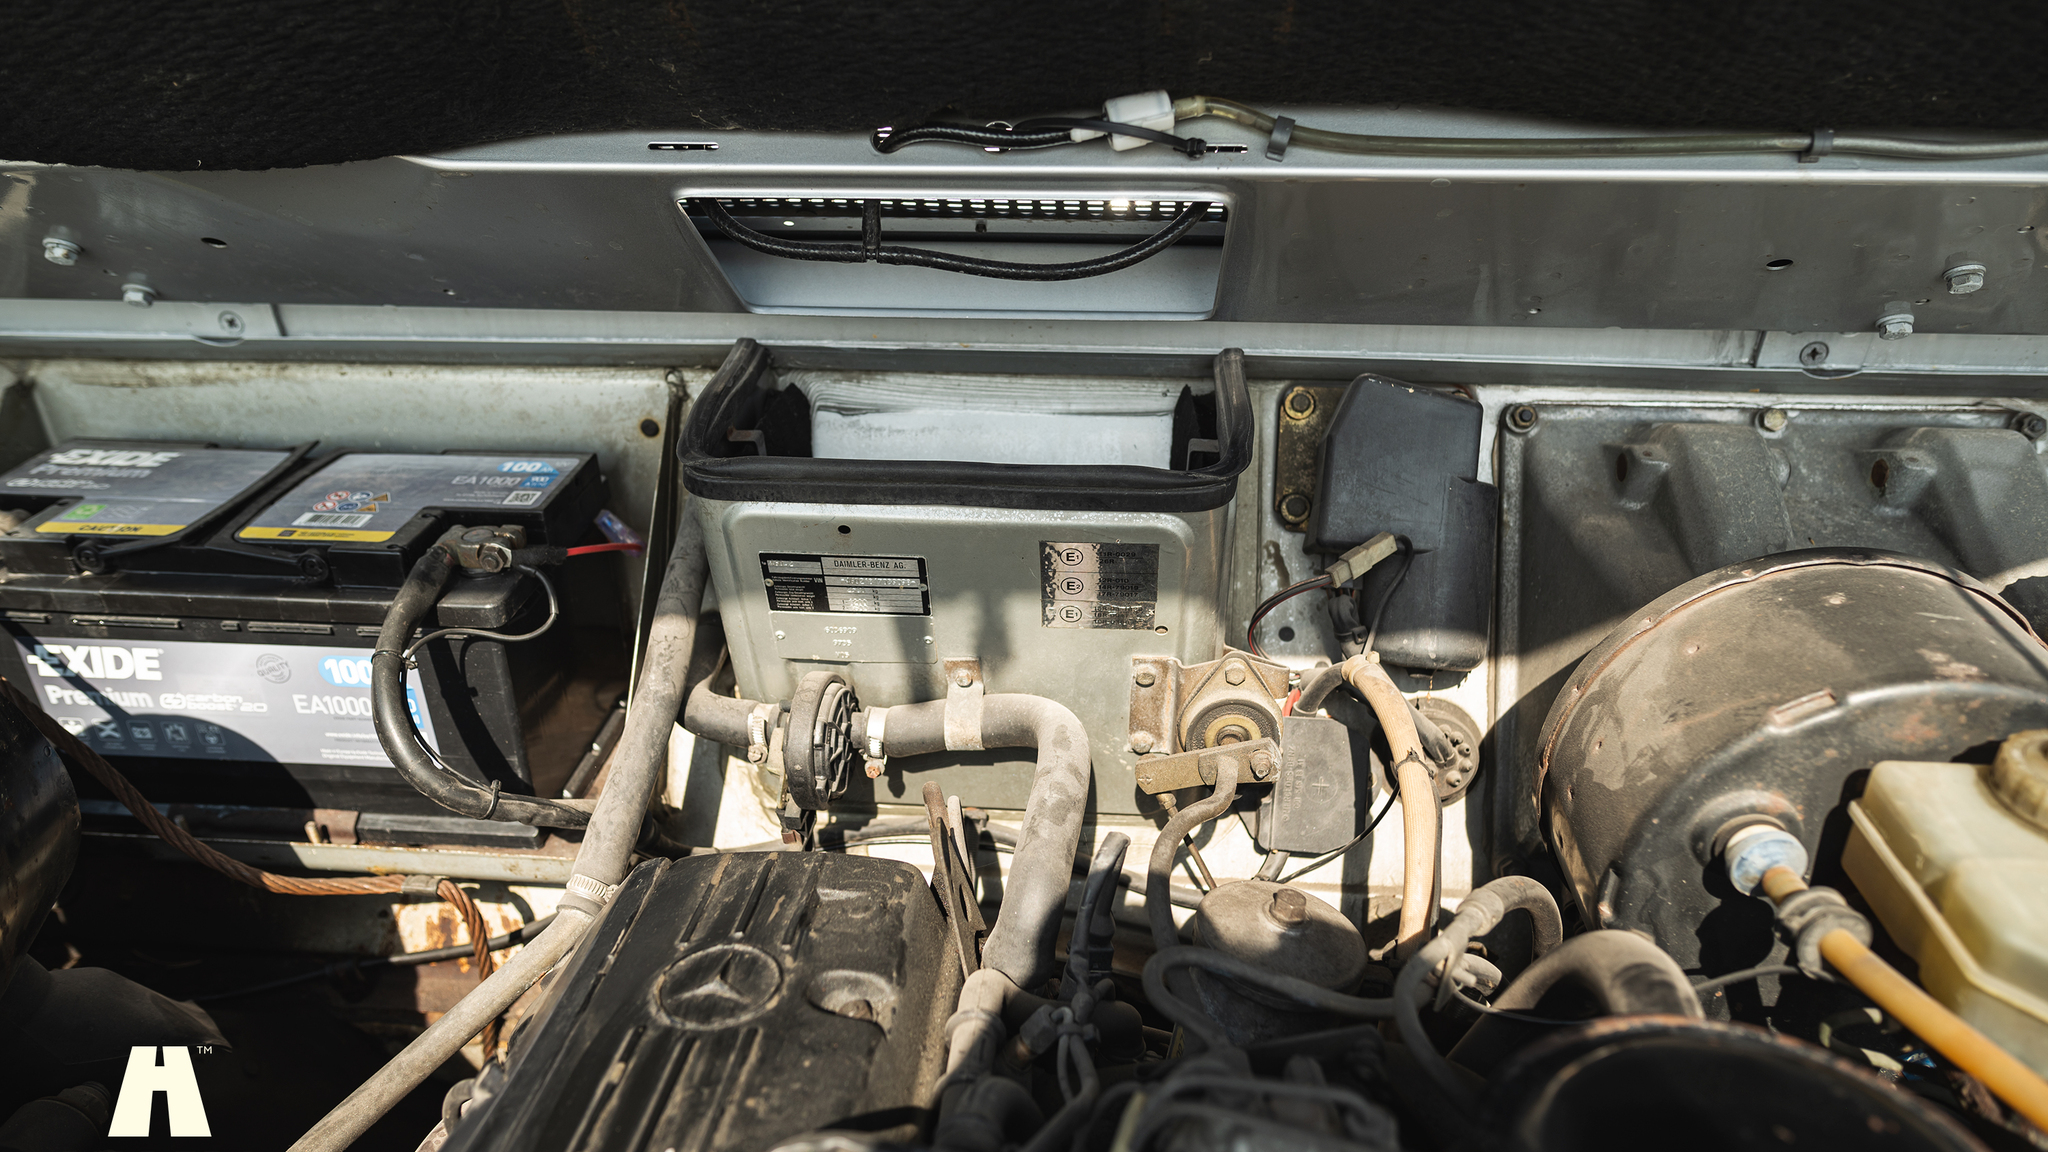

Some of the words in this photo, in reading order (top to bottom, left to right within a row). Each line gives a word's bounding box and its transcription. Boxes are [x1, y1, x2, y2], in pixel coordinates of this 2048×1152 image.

[502, 461, 541, 472] 100
[451, 475, 522, 486] EA1000
[833, 560, 891, 569] DAIMLER-BENZ
[27, 644, 163, 681] EXIDE
[44, 685, 155, 709] Premium
[185, 693, 243, 703] carbon
[292, 694, 373, 716] EA1000
